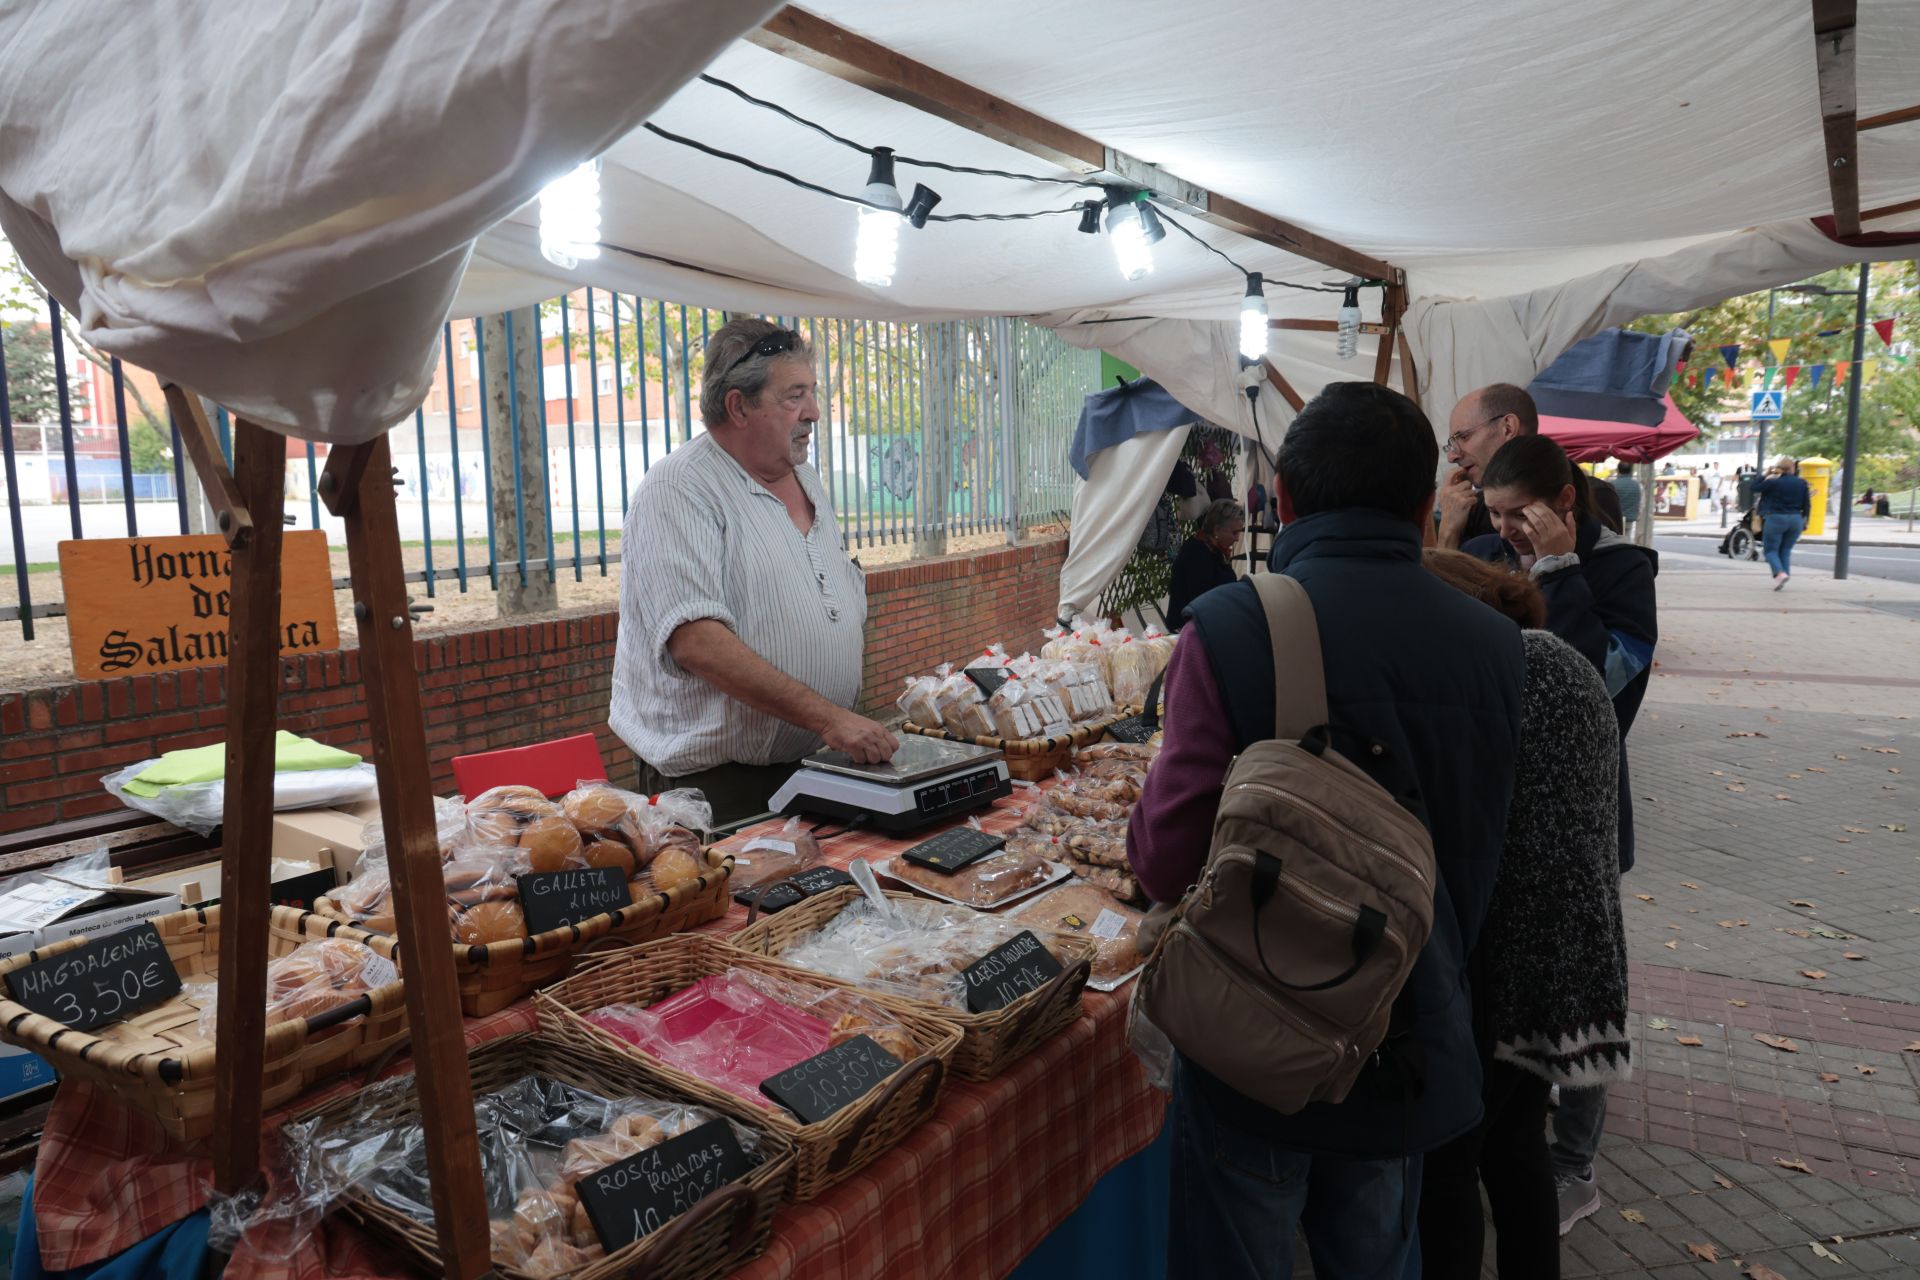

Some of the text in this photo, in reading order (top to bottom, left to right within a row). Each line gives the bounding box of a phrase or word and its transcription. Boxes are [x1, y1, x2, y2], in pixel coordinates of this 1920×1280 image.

[190, 583, 231, 619] de
[100, 620, 321, 673] Salamca
[532, 870, 607, 895] GALLETA
[570, 887, 620, 909] LIMON
[69, 924, 101, 937] Manteca
[113, 916, 134, 927] cerdo
[135, 909, 160, 921] ibérico
[21, 932, 161, 1000] MAGDALENAS
[967, 956, 1006, 987] LAZOS
[53, 962, 165, 1025] 3,50€
[779, 1041, 860, 1091] COCADAS
[597, 1150, 661, 1196] ROSCA
